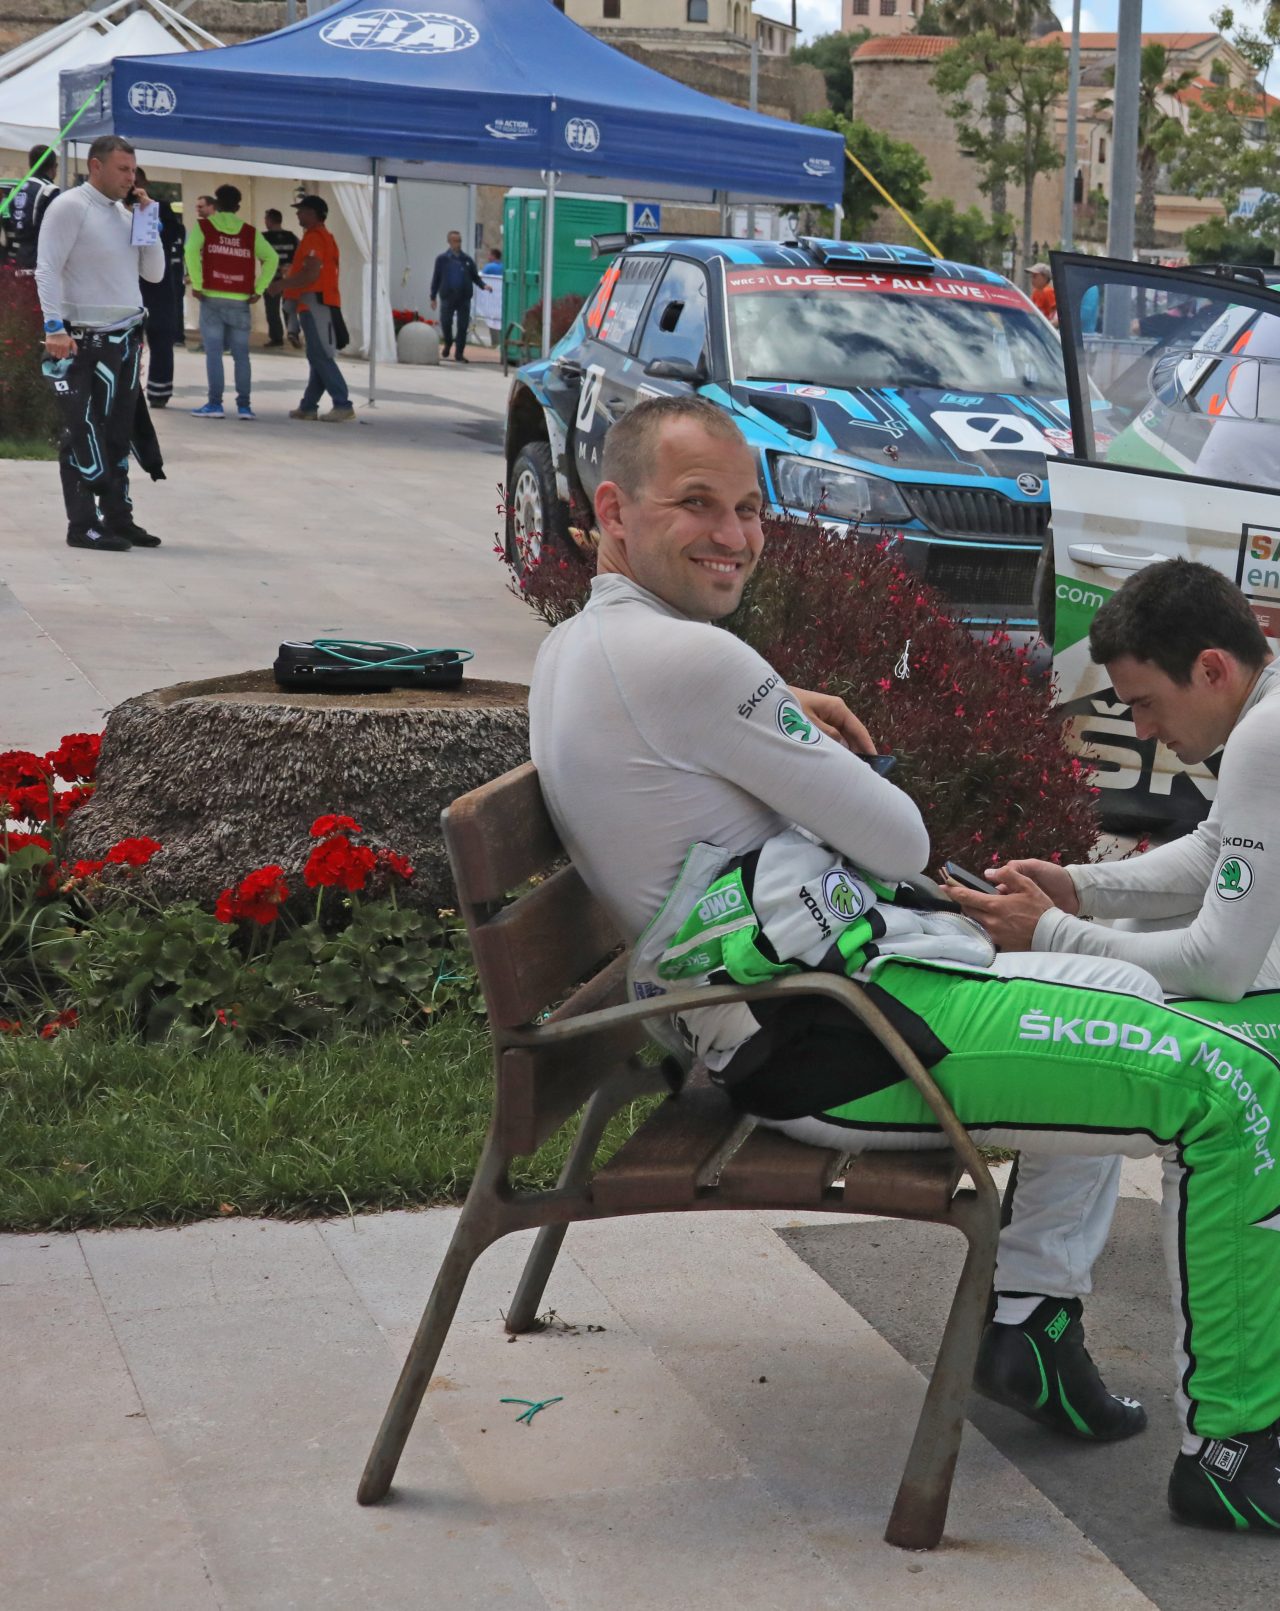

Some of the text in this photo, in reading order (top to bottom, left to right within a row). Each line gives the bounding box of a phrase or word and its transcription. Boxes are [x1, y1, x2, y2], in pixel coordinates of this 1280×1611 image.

[504, 120, 529, 128] ACTION
[208, 244, 251, 258] COMMANDER
[219, 236, 241, 247] STAGE
[730, 277, 755, 286] WRC
[892, 278, 934, 292] ALL
[936, 282, 985, 299] LIVE
[738, 674, 779, 719] ŠKODA
[698, 888, 741, 921] OMP
[799, 886, 832, 940] ŠKODA
[1019, 1008, 1276, 1177] ŠKODA Motorsport
[1047, 1310, 1068, 1339] OMP
[1220, 1451, 1231, 1467] OMP
